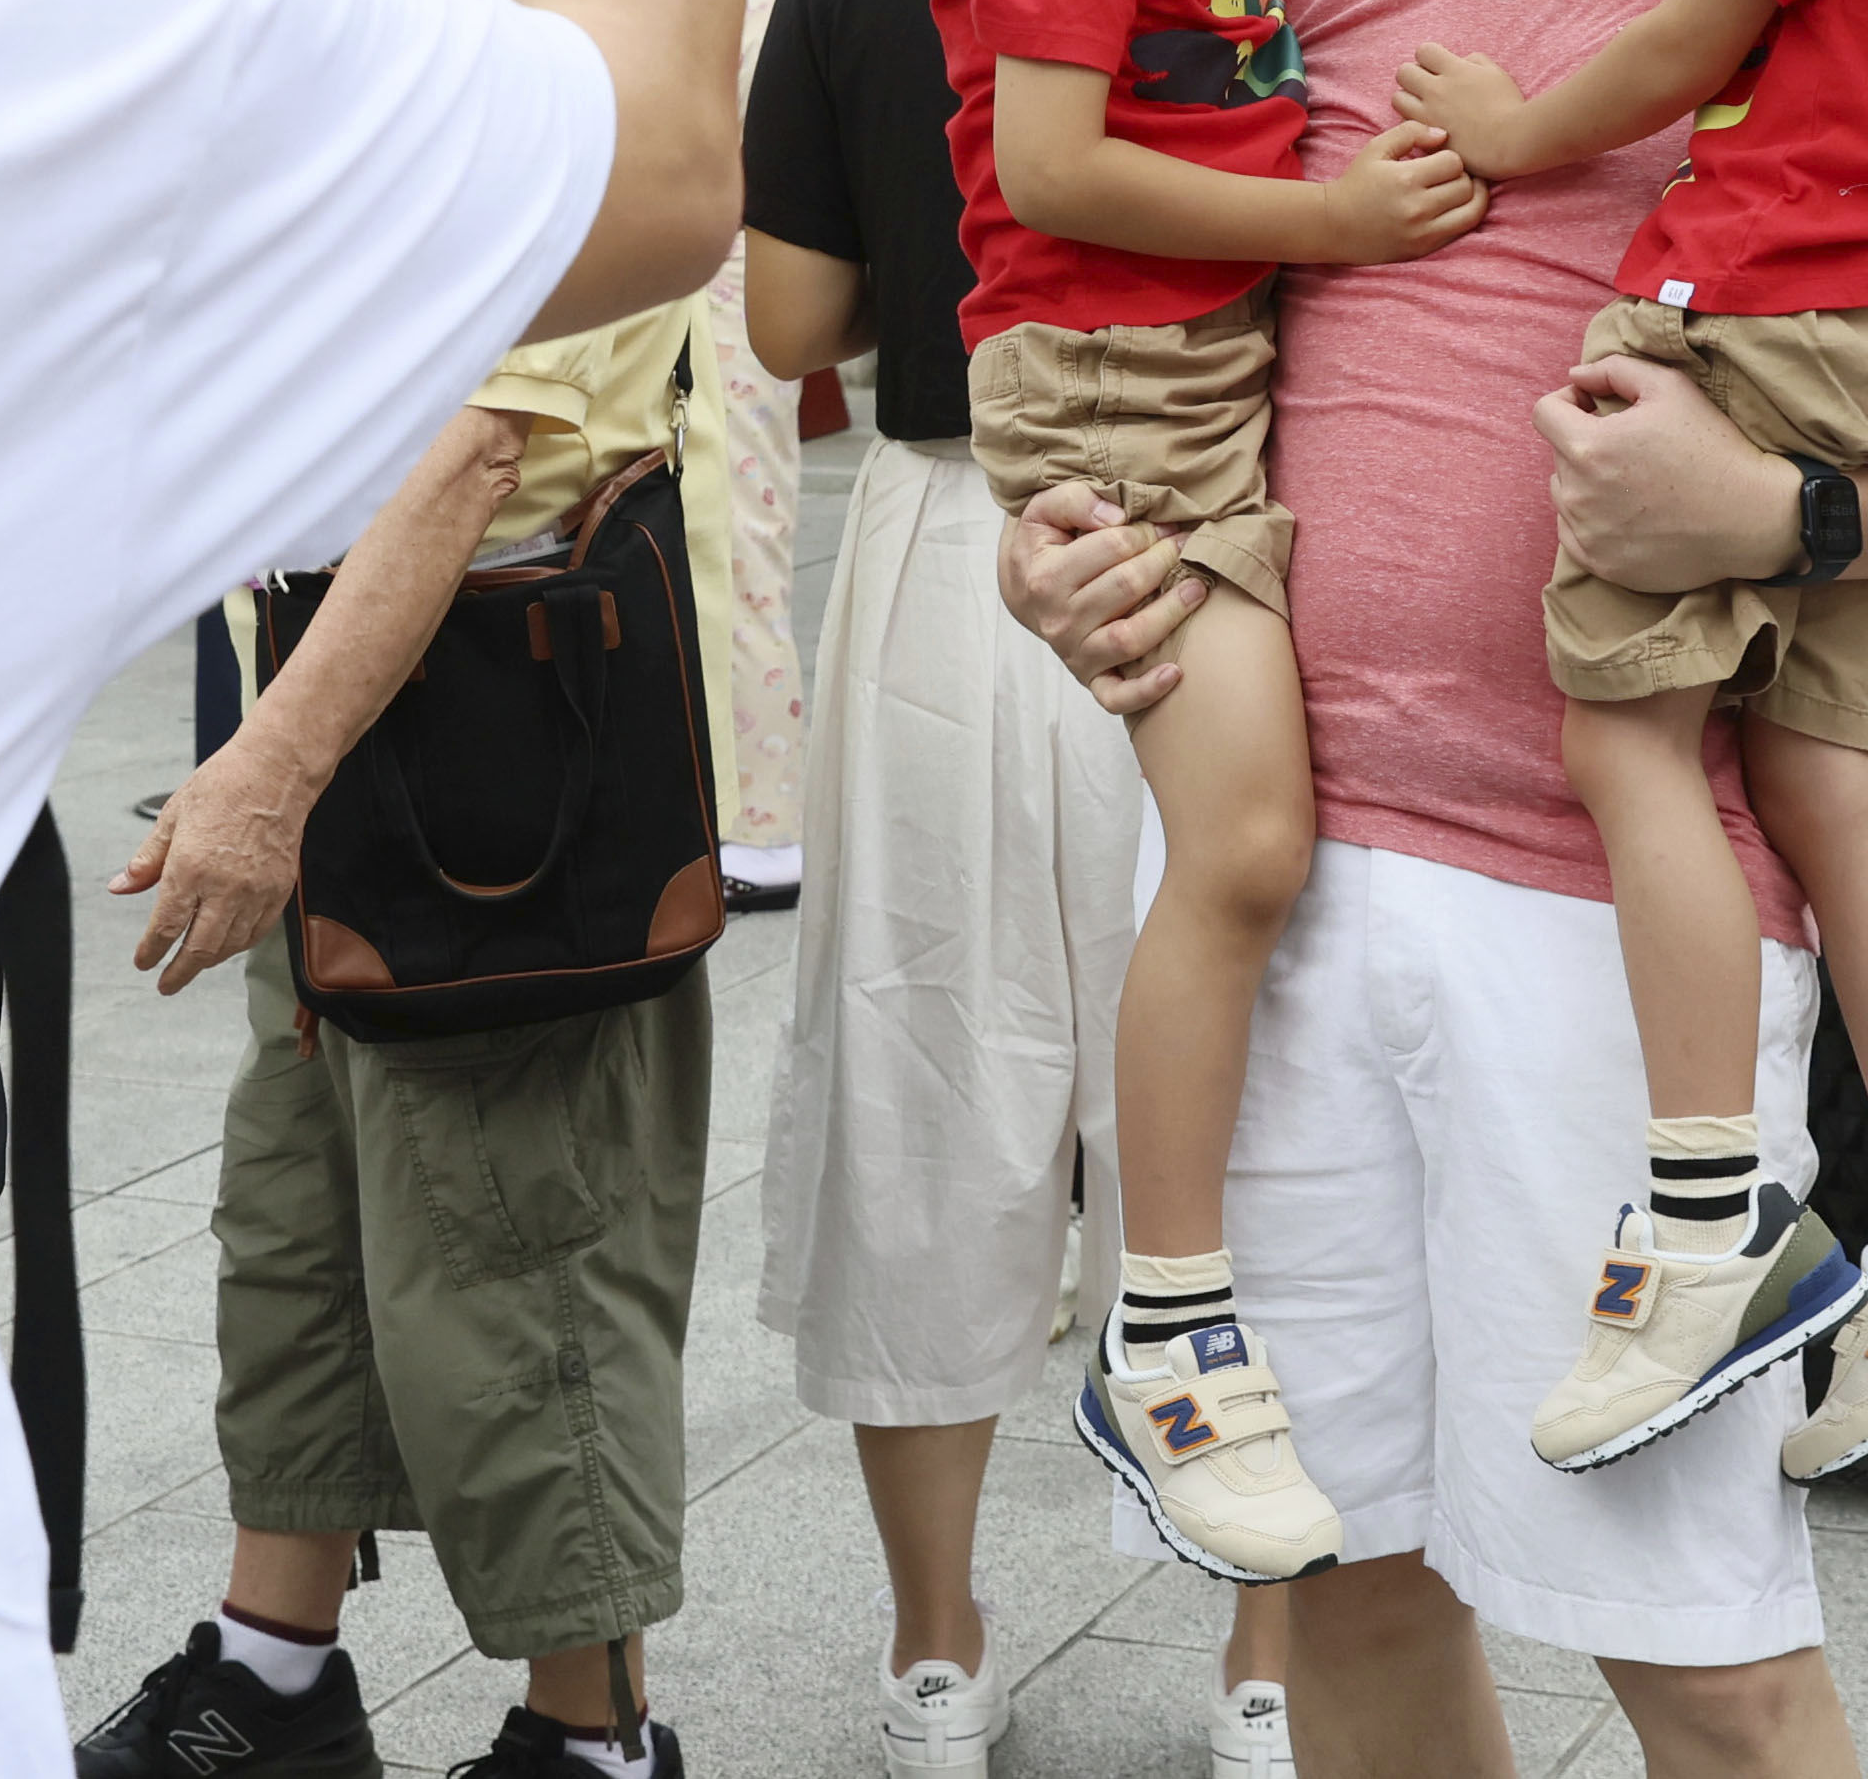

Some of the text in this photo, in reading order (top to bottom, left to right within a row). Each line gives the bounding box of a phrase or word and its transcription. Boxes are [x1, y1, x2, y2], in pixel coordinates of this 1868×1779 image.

[1591, 1260, 1652, 1320] N
[1145, 1392, 1220, 1456] N
[919, 1700, 948, 1708] AIR
[1245, 1721, 1274, 1730] AIR
[167, 1708, 255, 1776] N
